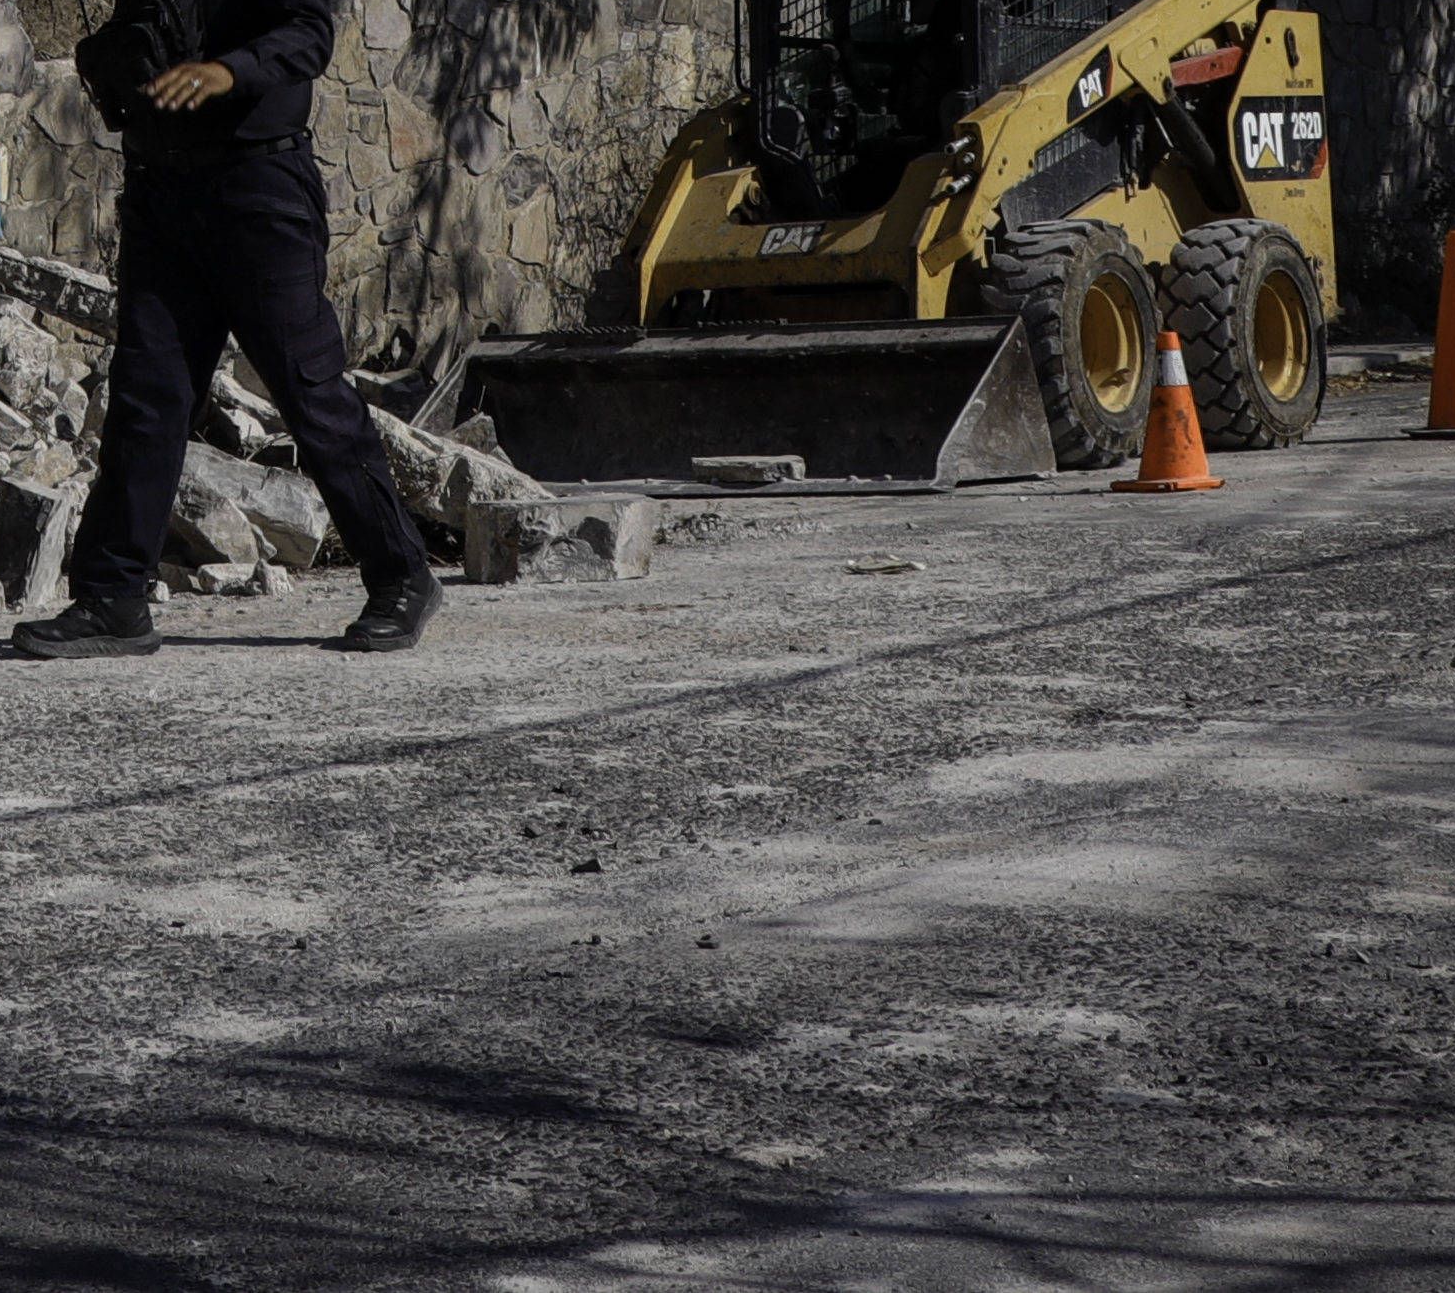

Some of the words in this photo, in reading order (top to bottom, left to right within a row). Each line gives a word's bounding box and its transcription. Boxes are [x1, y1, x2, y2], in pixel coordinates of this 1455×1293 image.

[1077, 67, 1104, 108] CAT
[1241, 111, 1285, 169] CAT
[1290, 111, 1322, 140] 262D
[759, 225, 823, 255] CAT
